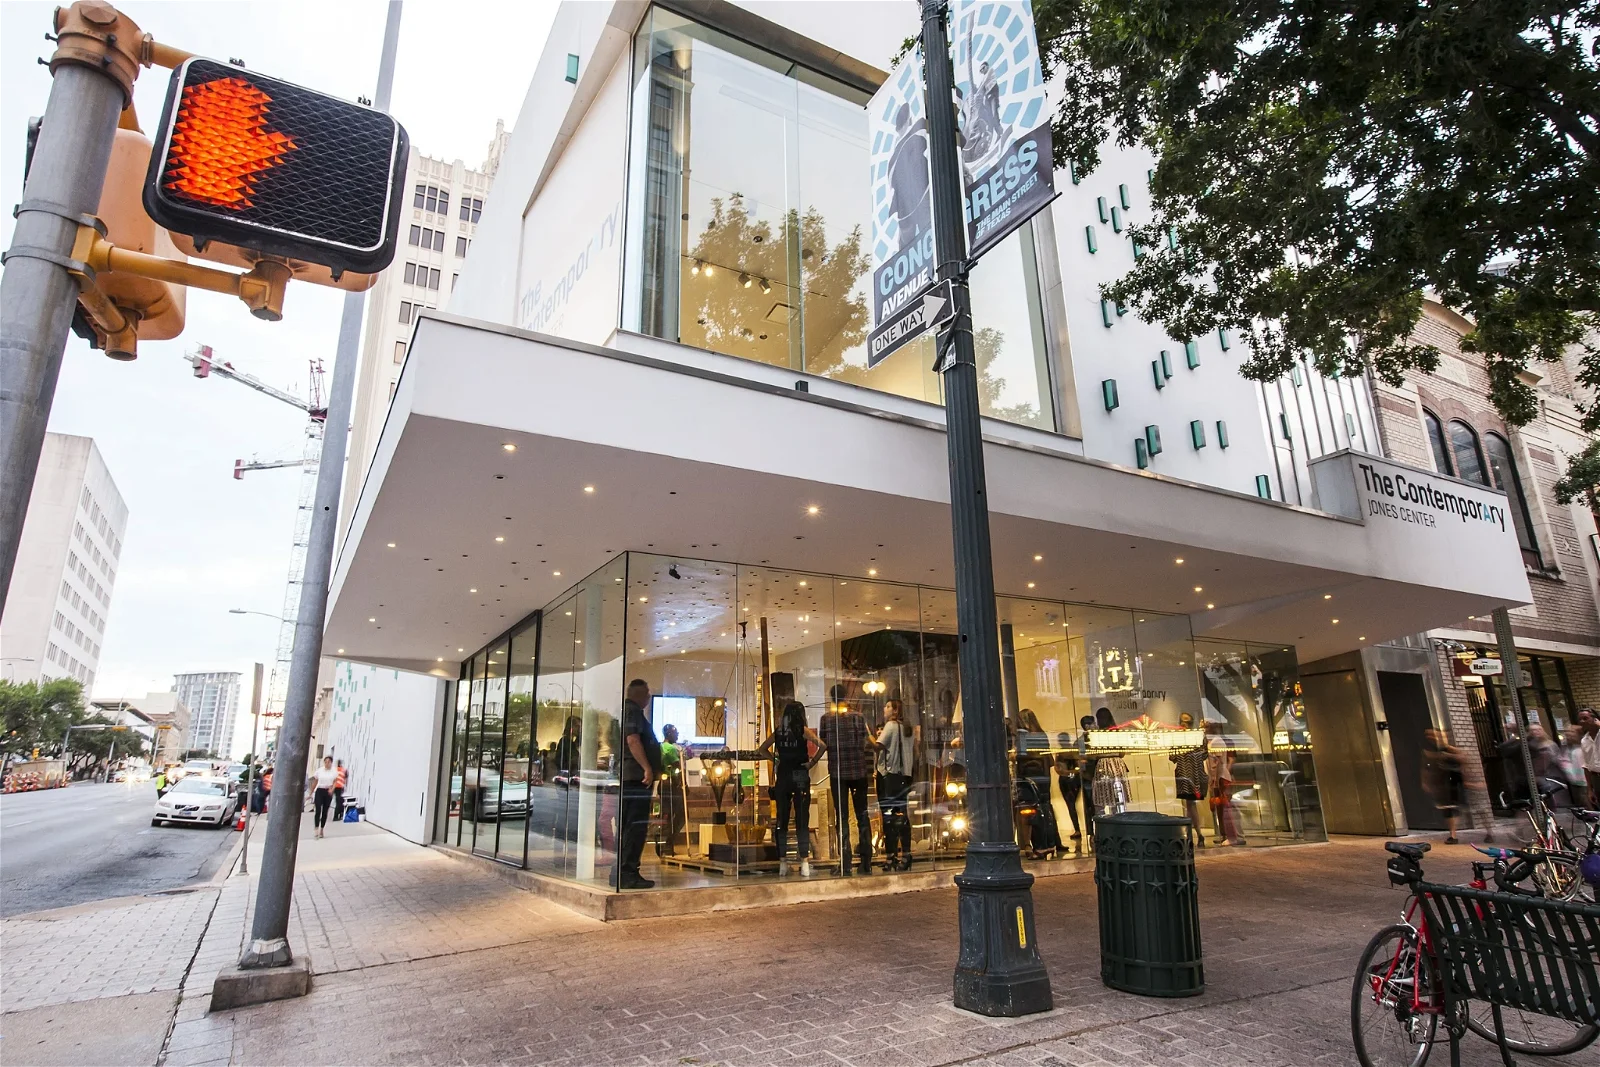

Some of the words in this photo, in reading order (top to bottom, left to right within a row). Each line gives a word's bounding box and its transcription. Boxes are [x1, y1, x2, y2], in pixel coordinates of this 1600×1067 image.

[976, 214, 991, 231] THE
[991, 197, 1011, 218] MAIN
[1011, 171, 1039, 203] STREET
[975, 226, 985, 240] OF
[986, 207, 1012, 228] TEXAS
[521, 279, 542, 322] The
[881, 266, 929, 320] AVENUE
[875, 326, 897, 352] ONE
[900, 306, 926, 333] WAY
[1359, 463, 1395, 497] The
[1368, 498, 1399, 519] JONES
[1400, 506, 1437, 529] CENTER
